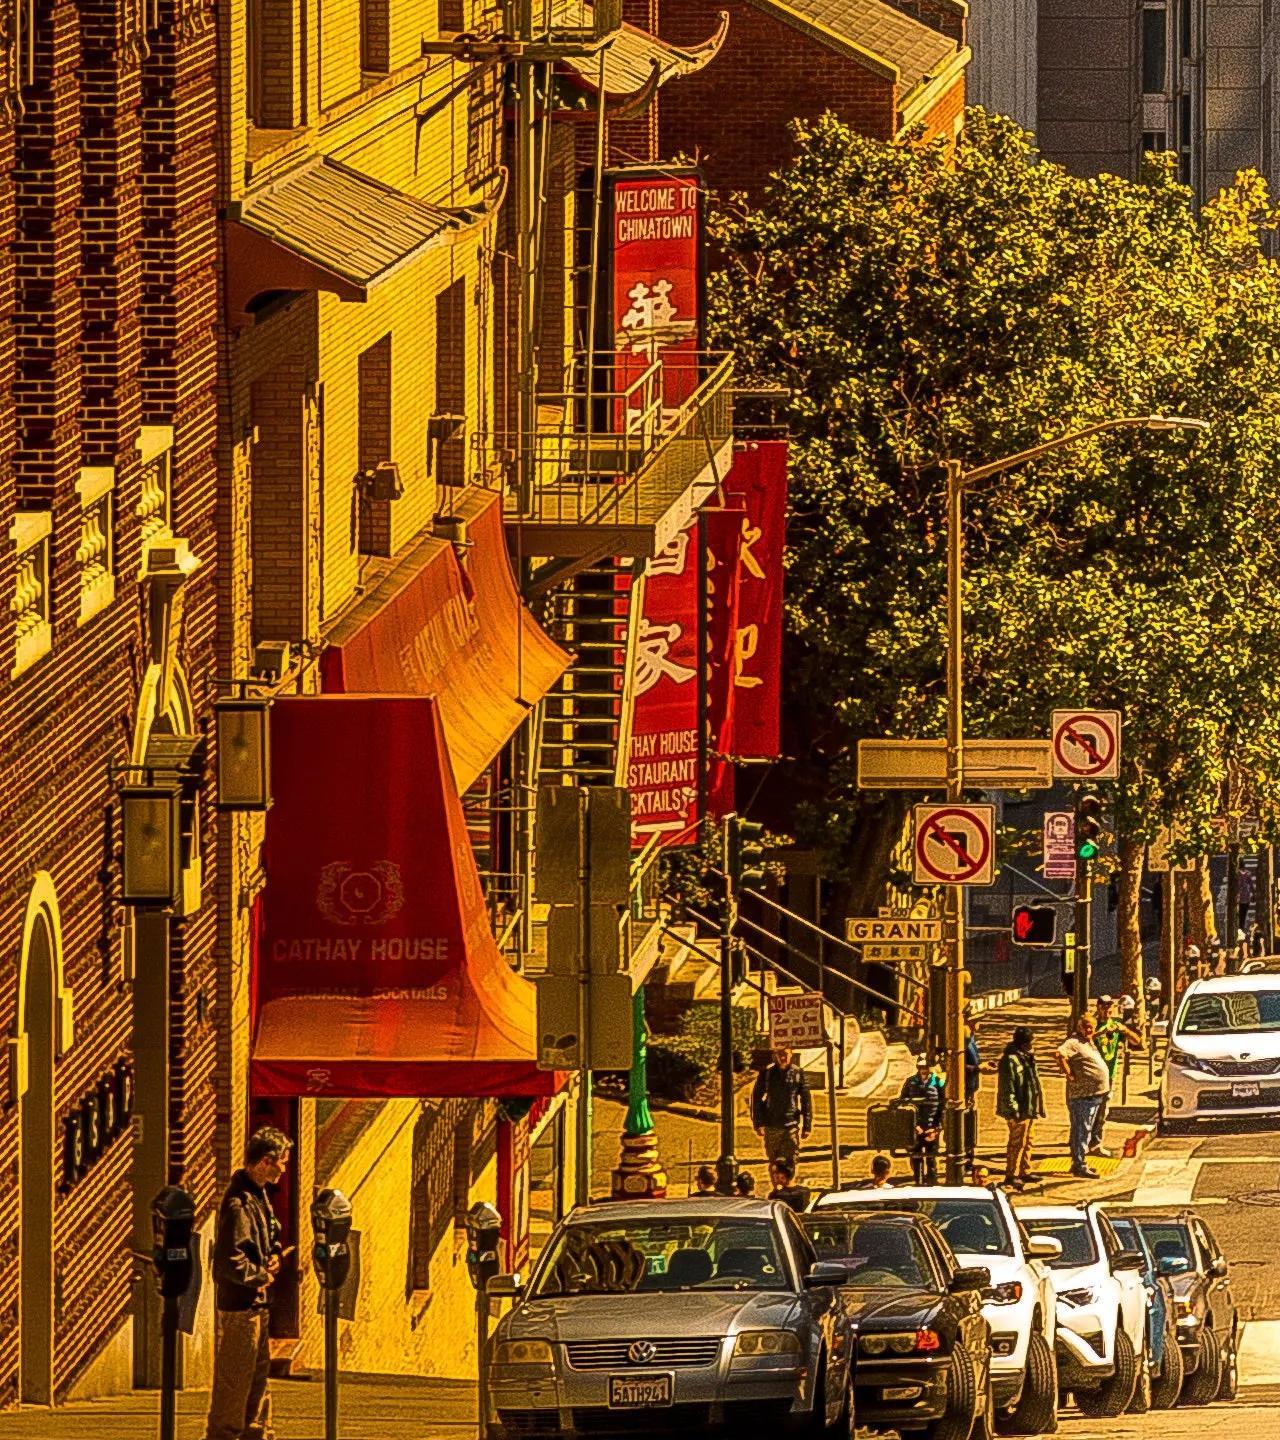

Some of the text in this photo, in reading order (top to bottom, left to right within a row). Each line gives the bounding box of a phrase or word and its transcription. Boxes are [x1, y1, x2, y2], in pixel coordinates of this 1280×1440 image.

[615, 186, 697, 213] WELCOME TO
[618, 215, 692, 243] CHINATOWN
[660, 729, 699, 755] HOUSE
[854, 922, 936, 939] GRANT
[272, 937, 450, 961] CATHAY HOUSE
